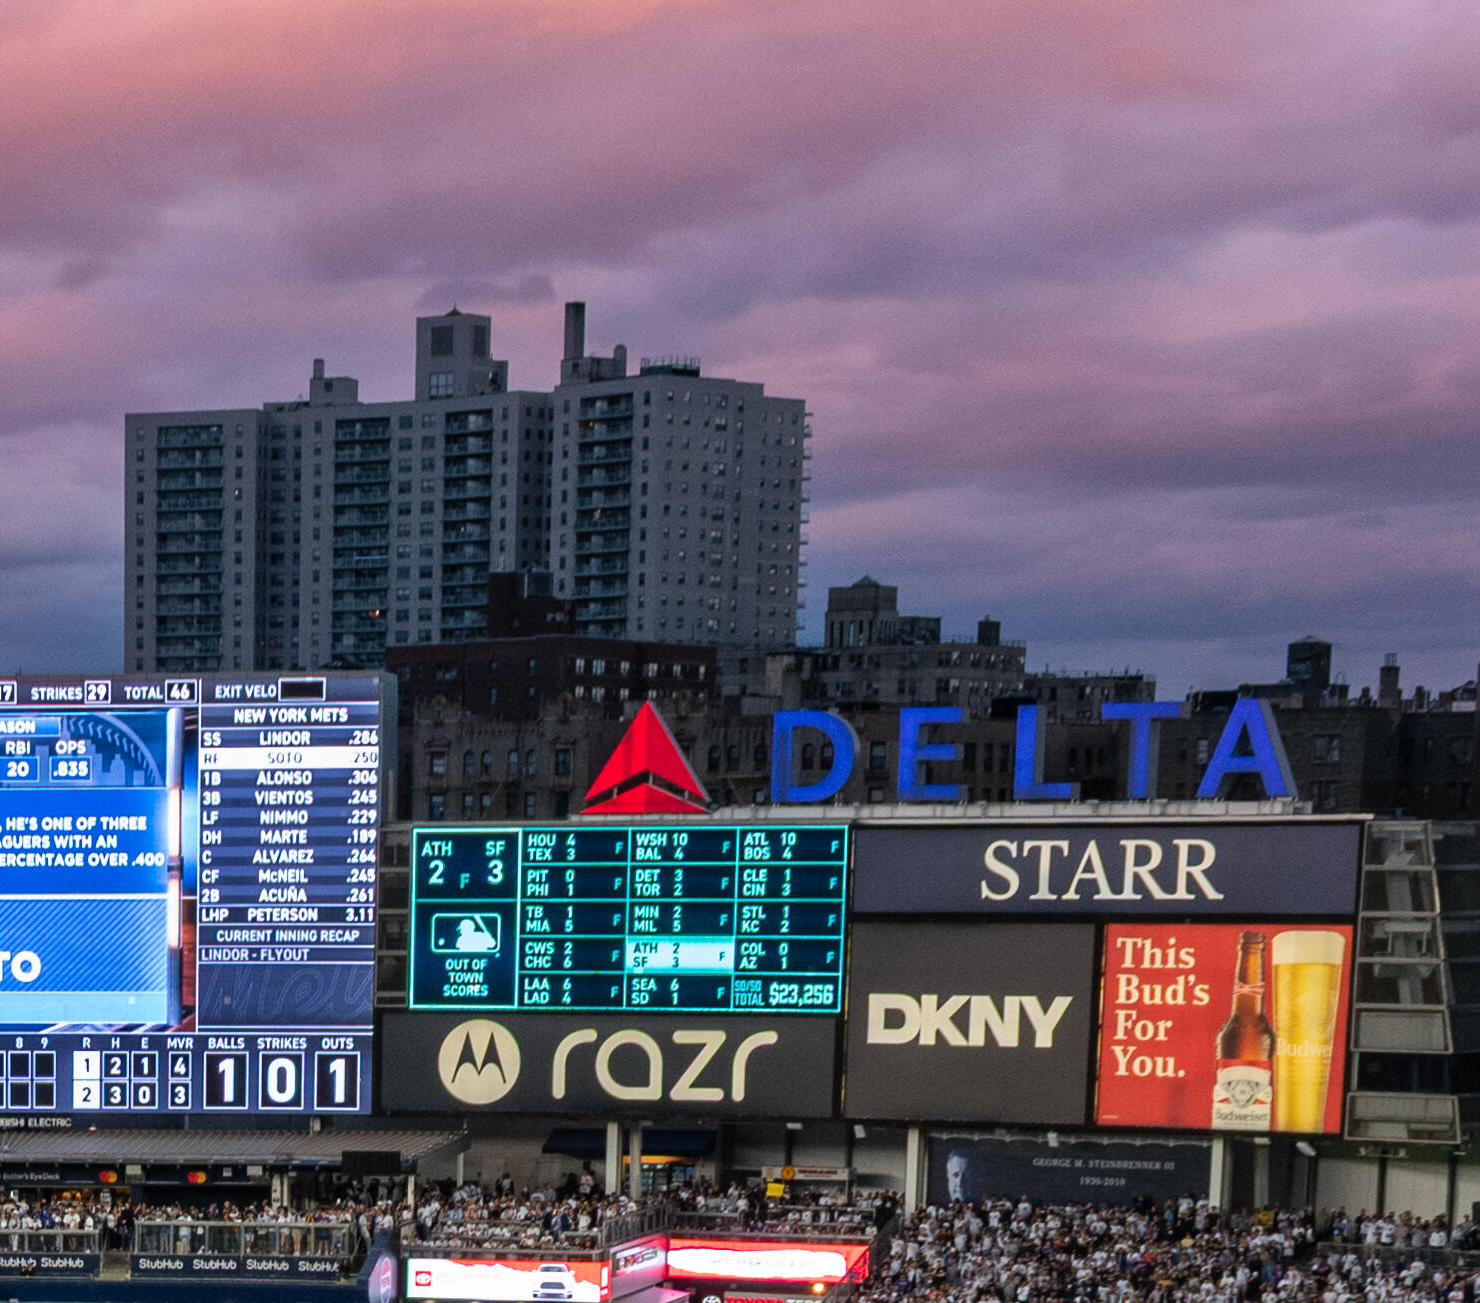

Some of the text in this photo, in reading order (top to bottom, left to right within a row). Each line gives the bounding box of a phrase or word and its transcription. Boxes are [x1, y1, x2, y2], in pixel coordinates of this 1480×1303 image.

[215, 684, 276, 699] EXIT VELO
[234, 707, 348, 724] NEW YORK METS
[259, 731, 311, 746] LINDOR
[770, 699, 1296, 804] DELTA
[254, 790, 313, 805] VIENTOS
[6, 817, 38, 831] HE'S
[41, 817, 72, 831] ONE
[76, 817, 96, 831] OF
[100, 817, 147, 831] THREE
[53, 835, 93, 849] WITH
[96, 835, 117, 848] AN
[88, 853, 128, 866] OVER
[132, 853, 165, 867] .400
[252, 849, 314, 864] ALVAREZ
[980, 838, 1224, 901] STARR
[259, 886, 307, 902] ACUÑA
[1116, 936, 1195, 970] This
[445, 959, 487, 970] OUT OF
[449, 972, 483, 983] TOWN
[443, 985, 488, 996] SCORES
[769, 981, 834, 1006] $23,256
[1114, 974, 1211, 1006] Bud's
[866, 993, 1074, 1048] DKNY
[1113, 1009, 1173, 1042] For
[208, 1037, 354, 1050] BALLS STRIKES OUTS
[551, 1028, 779, 1102] razr
[1112, 1046, 1186, 1079] You.
[218, 1058, 346, 1104] 1 0 1
[28, 1117, 71, 1128] ELECTRIC
